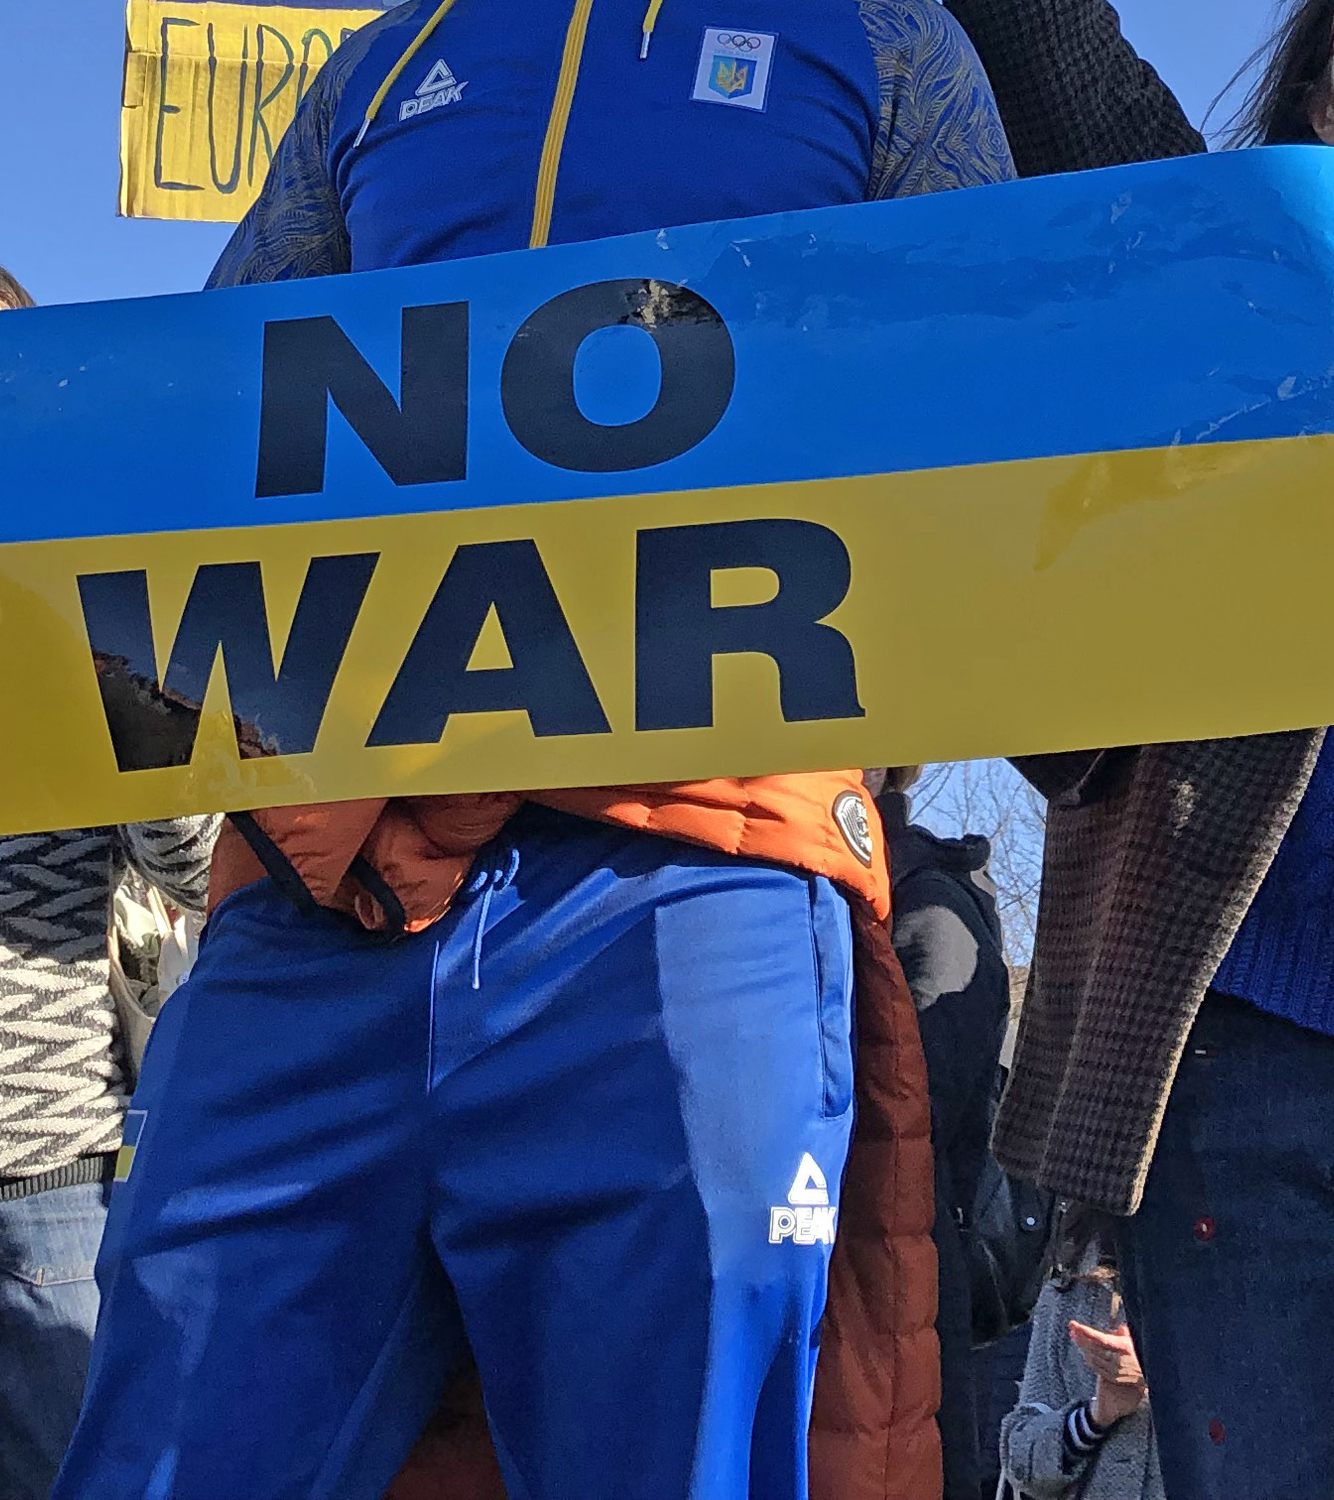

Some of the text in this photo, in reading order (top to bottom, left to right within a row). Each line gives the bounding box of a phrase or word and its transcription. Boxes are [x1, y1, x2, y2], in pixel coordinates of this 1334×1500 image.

[398, 80, 469, 122] PEAK
[255, 277, 737, 499] NO
[76, 518, 867, 773] WAR
[768, 1206, 836, 1245] PEAK
